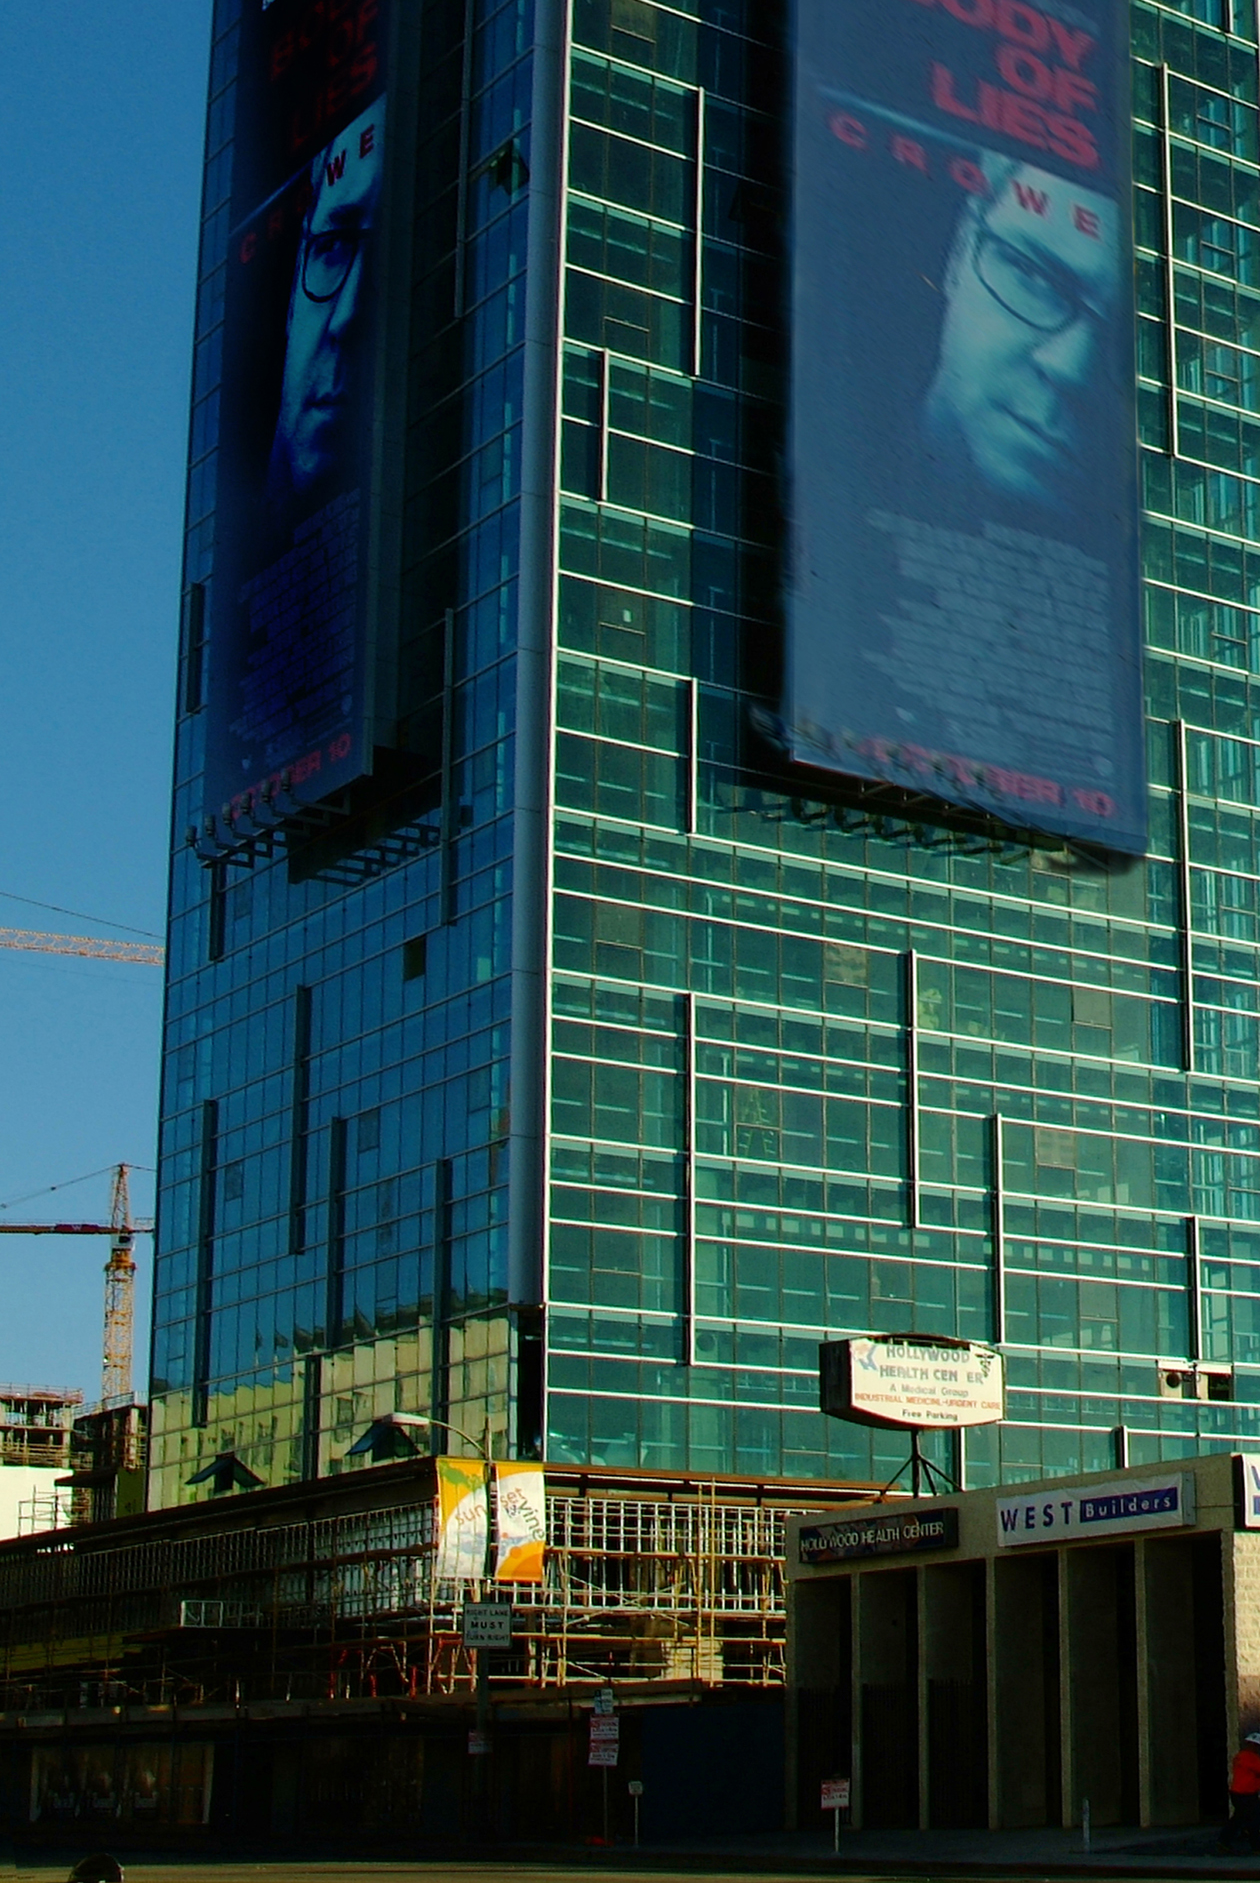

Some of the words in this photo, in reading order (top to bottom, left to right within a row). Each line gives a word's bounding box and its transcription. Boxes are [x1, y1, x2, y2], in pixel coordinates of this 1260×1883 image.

[996, 44, 1098, 114] OF
[287, 41, 379, 158] LIES
[930, 61, 1101, 170] LIES
[829, 112, 1102, 241] CROWE
[239, 123, 375, 265] CROWE
[1071, 788, 1115, 817] 10
[886, 1344, 970, 1364] HOLLYWOOD
[880, 1365, 929, 1380] HEALTH
[933, 1368, 984, 1385] CENER
[855, 1392, 903, 1404] INDUSTRIAL
[981, 1401, 1001, 1410] CARE
[890, 1383, 897, 1392] A
[901, 1385, 936, 1395] Medical
[941, 1387, 969, 1398] Group
[902, 1408, 922, 1418] Free
[926, 1410, 958, 1422] Parking
[455, 1504, 488, 1526] sun
[1000, 1501, 1073, 1533] WEST
[1085, 1496, 1172, 1519] Builders
[800, 1531, 860, 1553] HOLLYWOOD
[861, 1527, 900, 1546] HEALTH
[903, 1521, 944, 1540] CENTER
[466, 1608, 487, 1616] RIGHT
[490, 1609, 509, 1617] LANE
[471, 1620, 505, 1630] MUST
[466, 1633, 485, 1641] TURN
[488, 1634, 510, 1642] RIGHT
